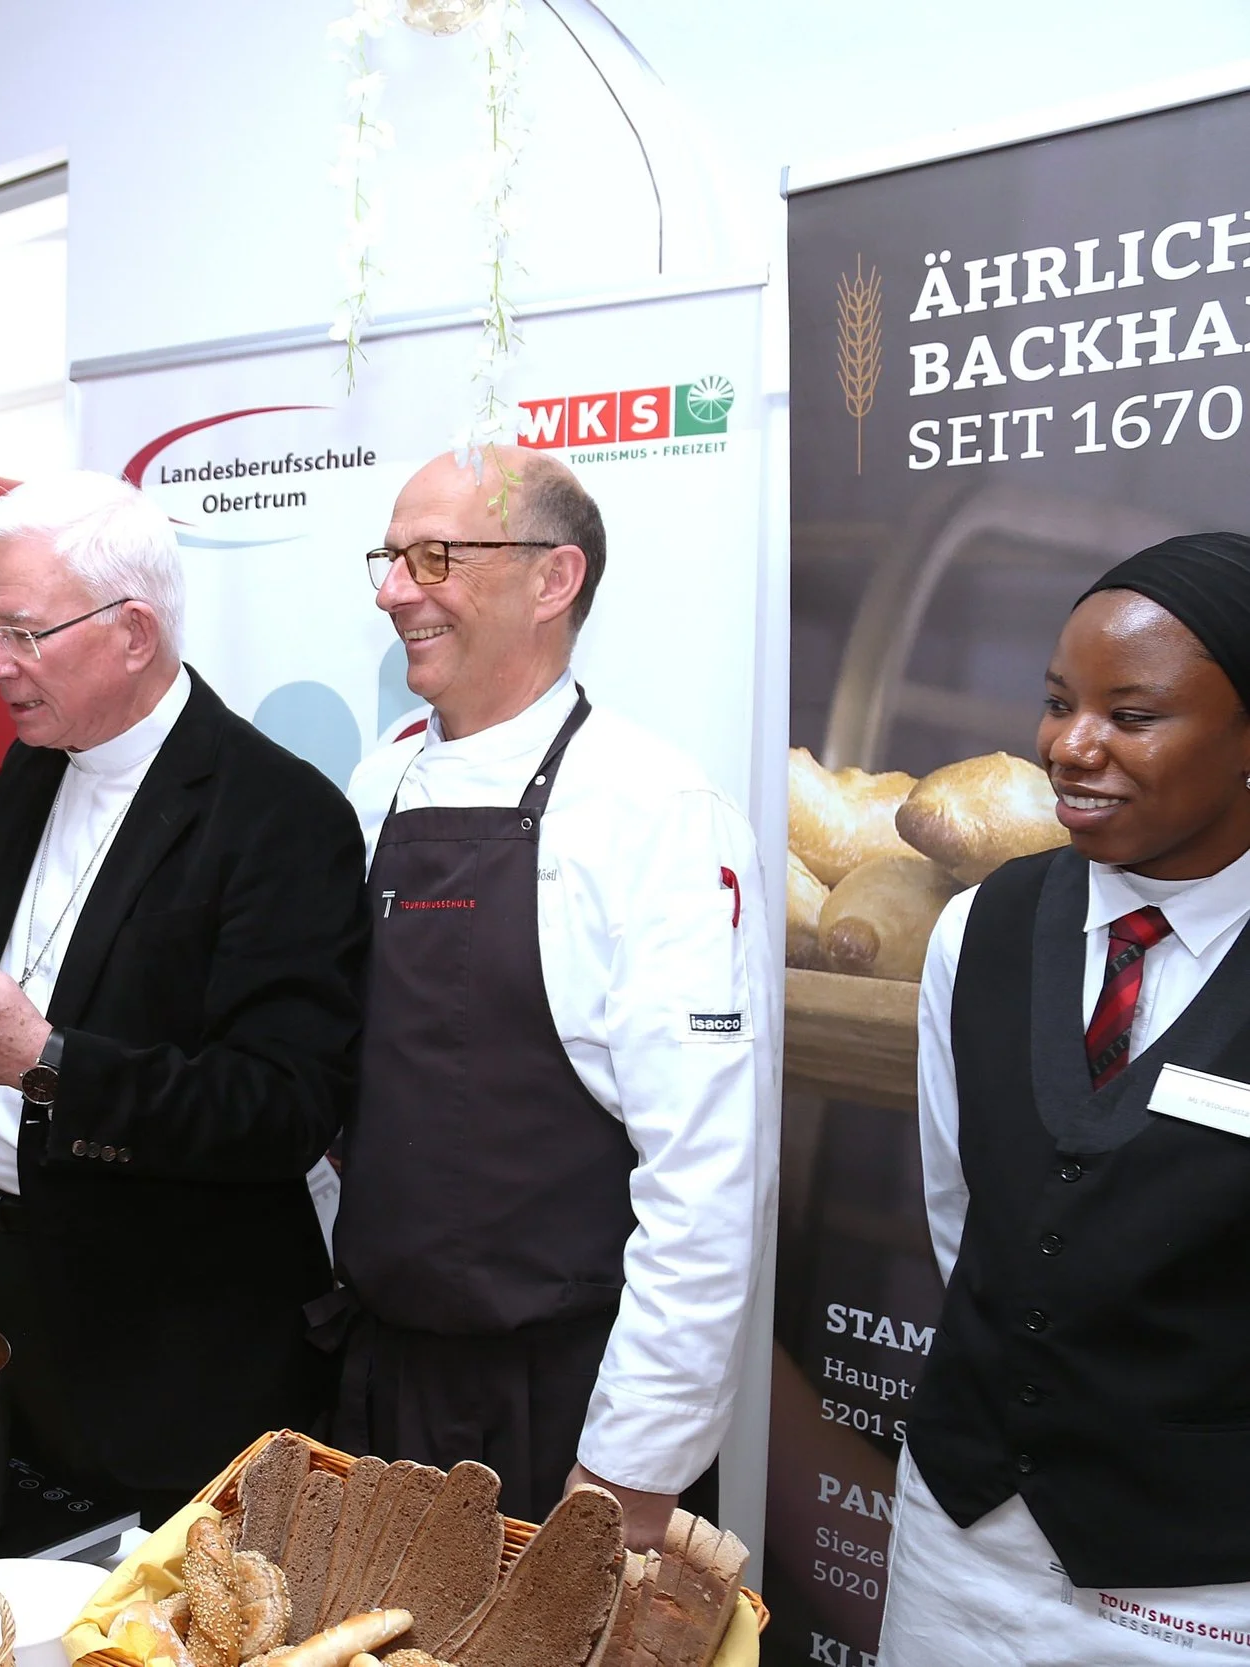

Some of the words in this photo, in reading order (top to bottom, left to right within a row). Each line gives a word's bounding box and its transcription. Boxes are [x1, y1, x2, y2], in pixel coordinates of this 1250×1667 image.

[909, 296, 1250, 397] BACKHA
[525, 394, 659, 444] WKS
[908, 405, 1054, 470] SEIT
[1071, 385, 1243, 455] 1670
[161, 446, 377, 484] Landesberufsschule
[569, 447, 648, 465] TOURISMUS
[662, 441, 727, 457] FREIZEIT
[202, 490, 307, 514] Obertrum
[690, 1015, 740, 1030] isacco
[826, 1303, 936, 1356] STAM
[823, 1356, 916, 1401] Haupt
[821, 1398, 884, 1437] 5201
[816, 1526, 889, 1571] Sieze
[813, 1559, 879, 1600] 5020
[1098, 1608, 1194, 1649] KLESSHEIM
